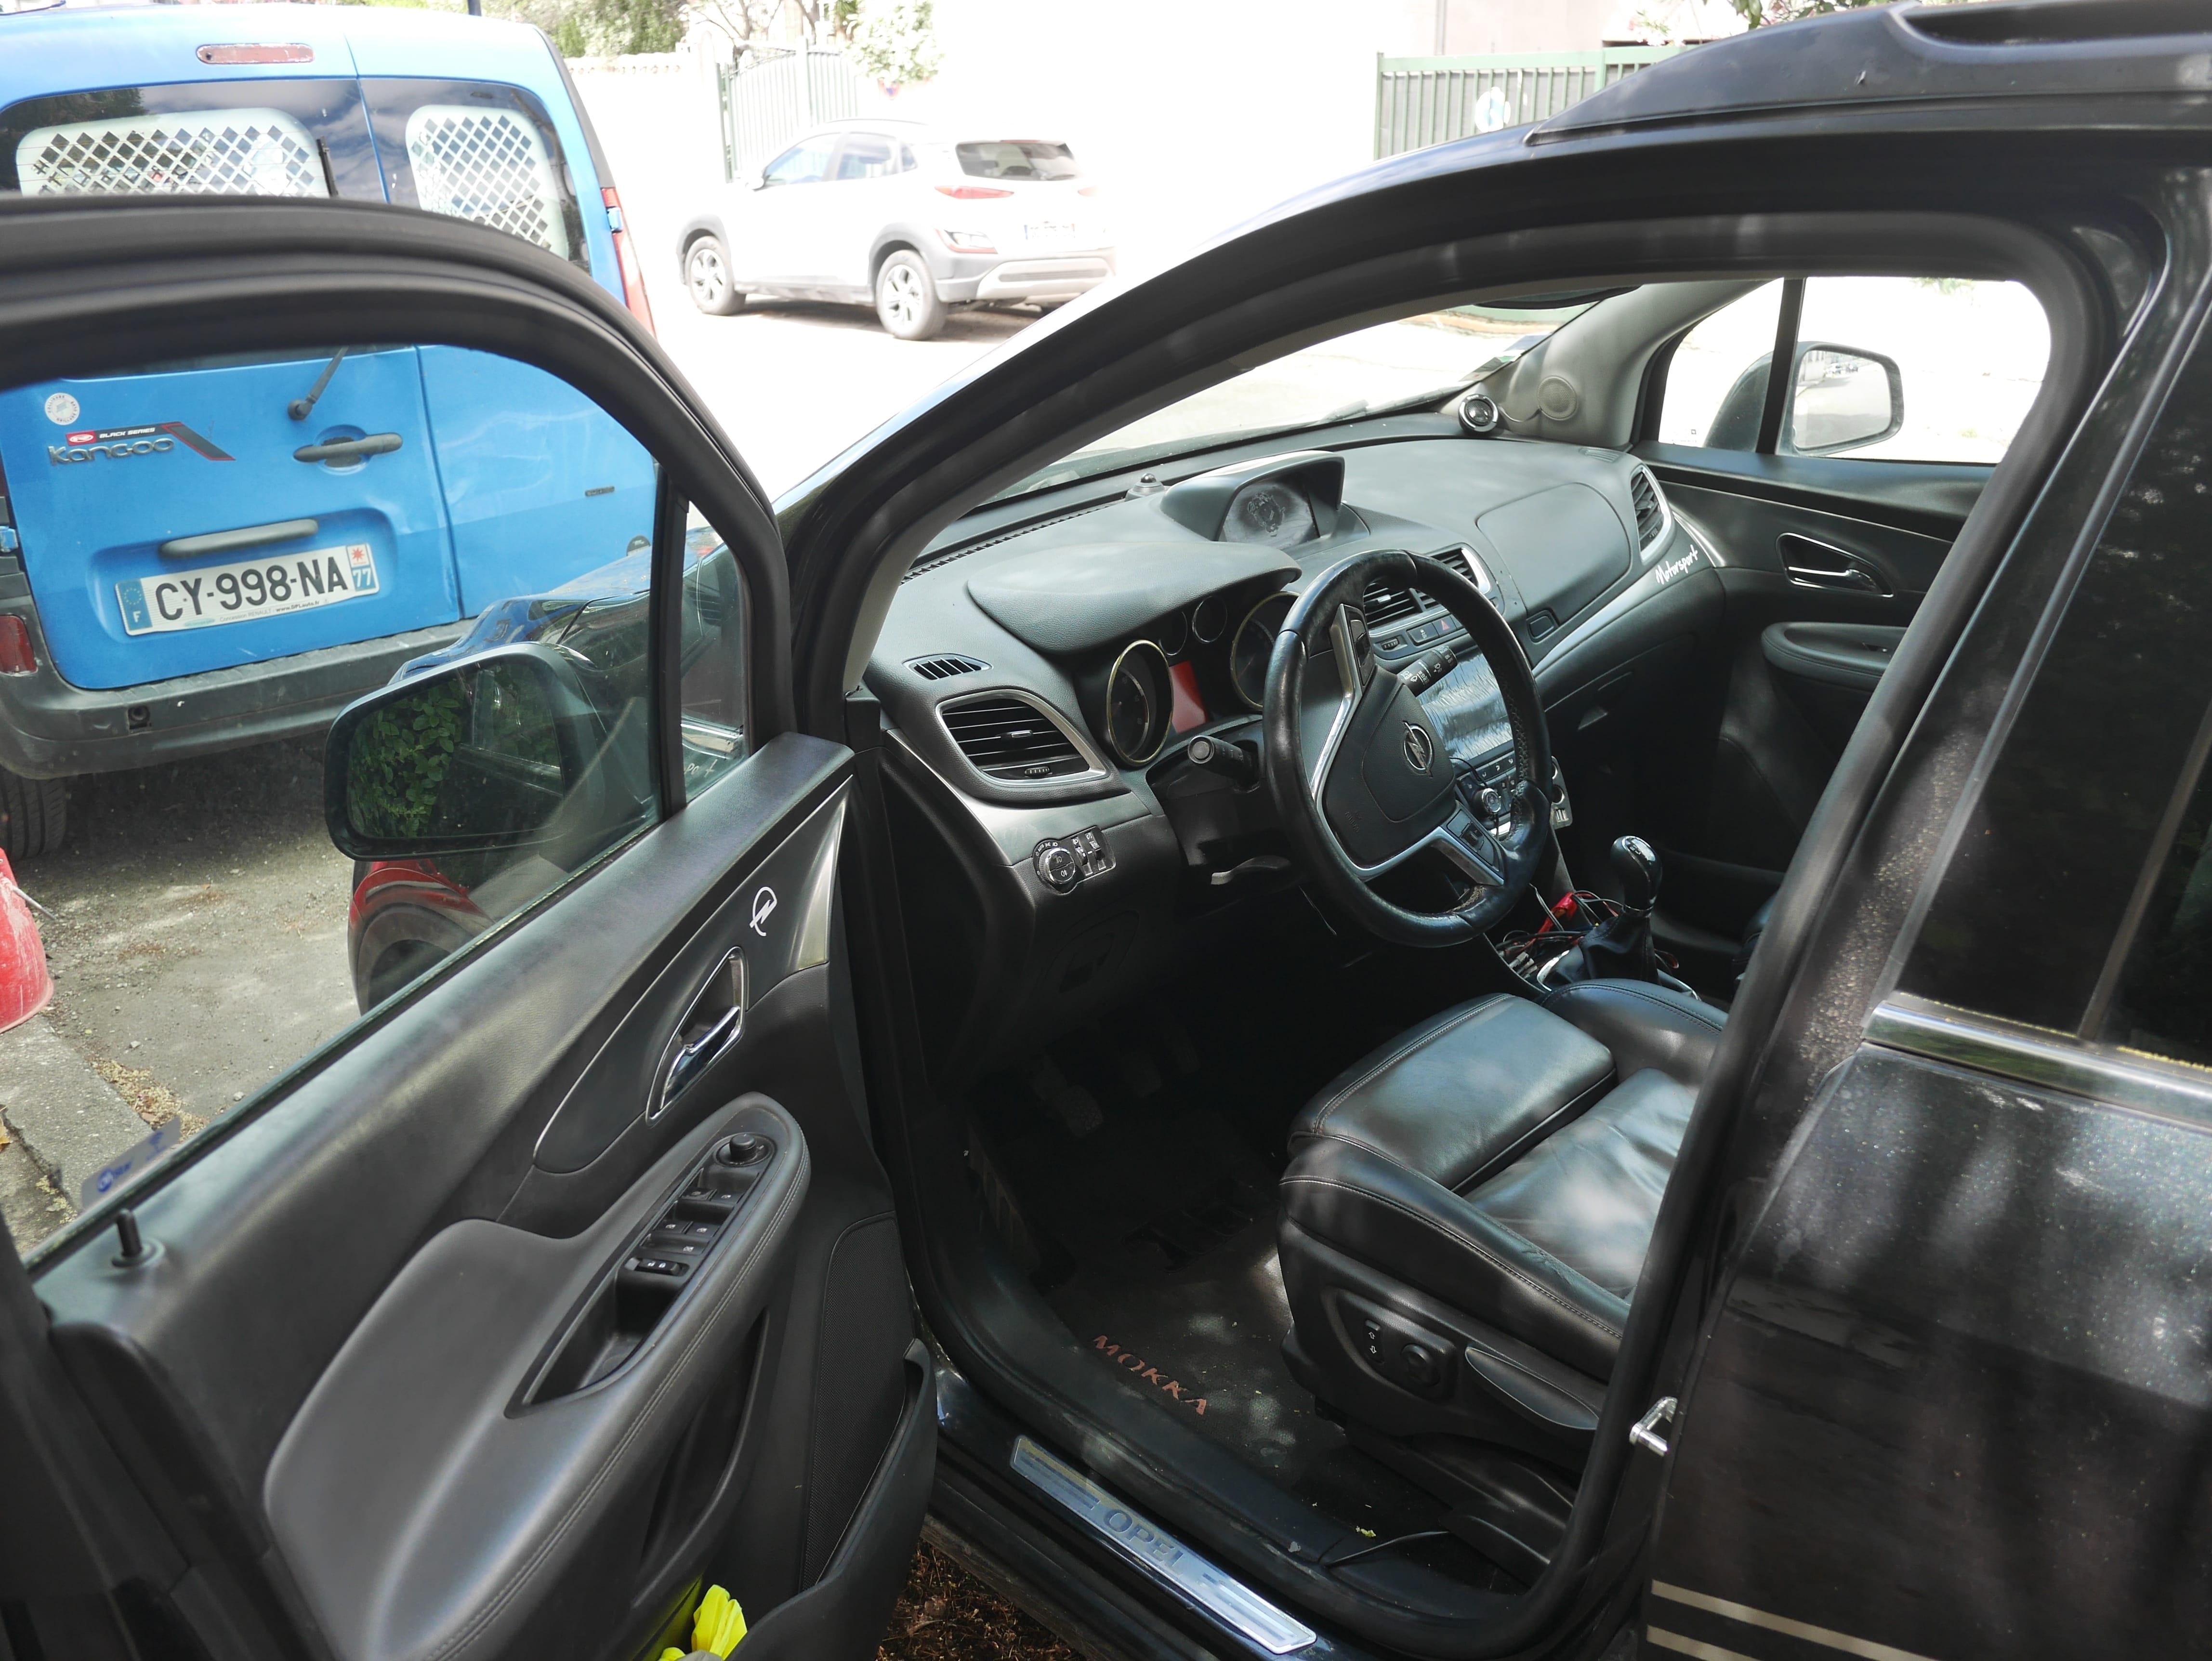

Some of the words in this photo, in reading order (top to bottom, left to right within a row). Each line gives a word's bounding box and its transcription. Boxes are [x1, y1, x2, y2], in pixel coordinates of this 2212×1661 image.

[128, 427, 155, 435] SERIES
[353, 567, 371, 587] 77
[1655, 544, 1698, 585] Motorsport
[156, 556, 348, 620] CY-998-NA
[133, 611, 141, 622] F
[1093, 1335, 1207, 1415] MOKKA
[1104, 1509, 1184, 1576] OPEL
